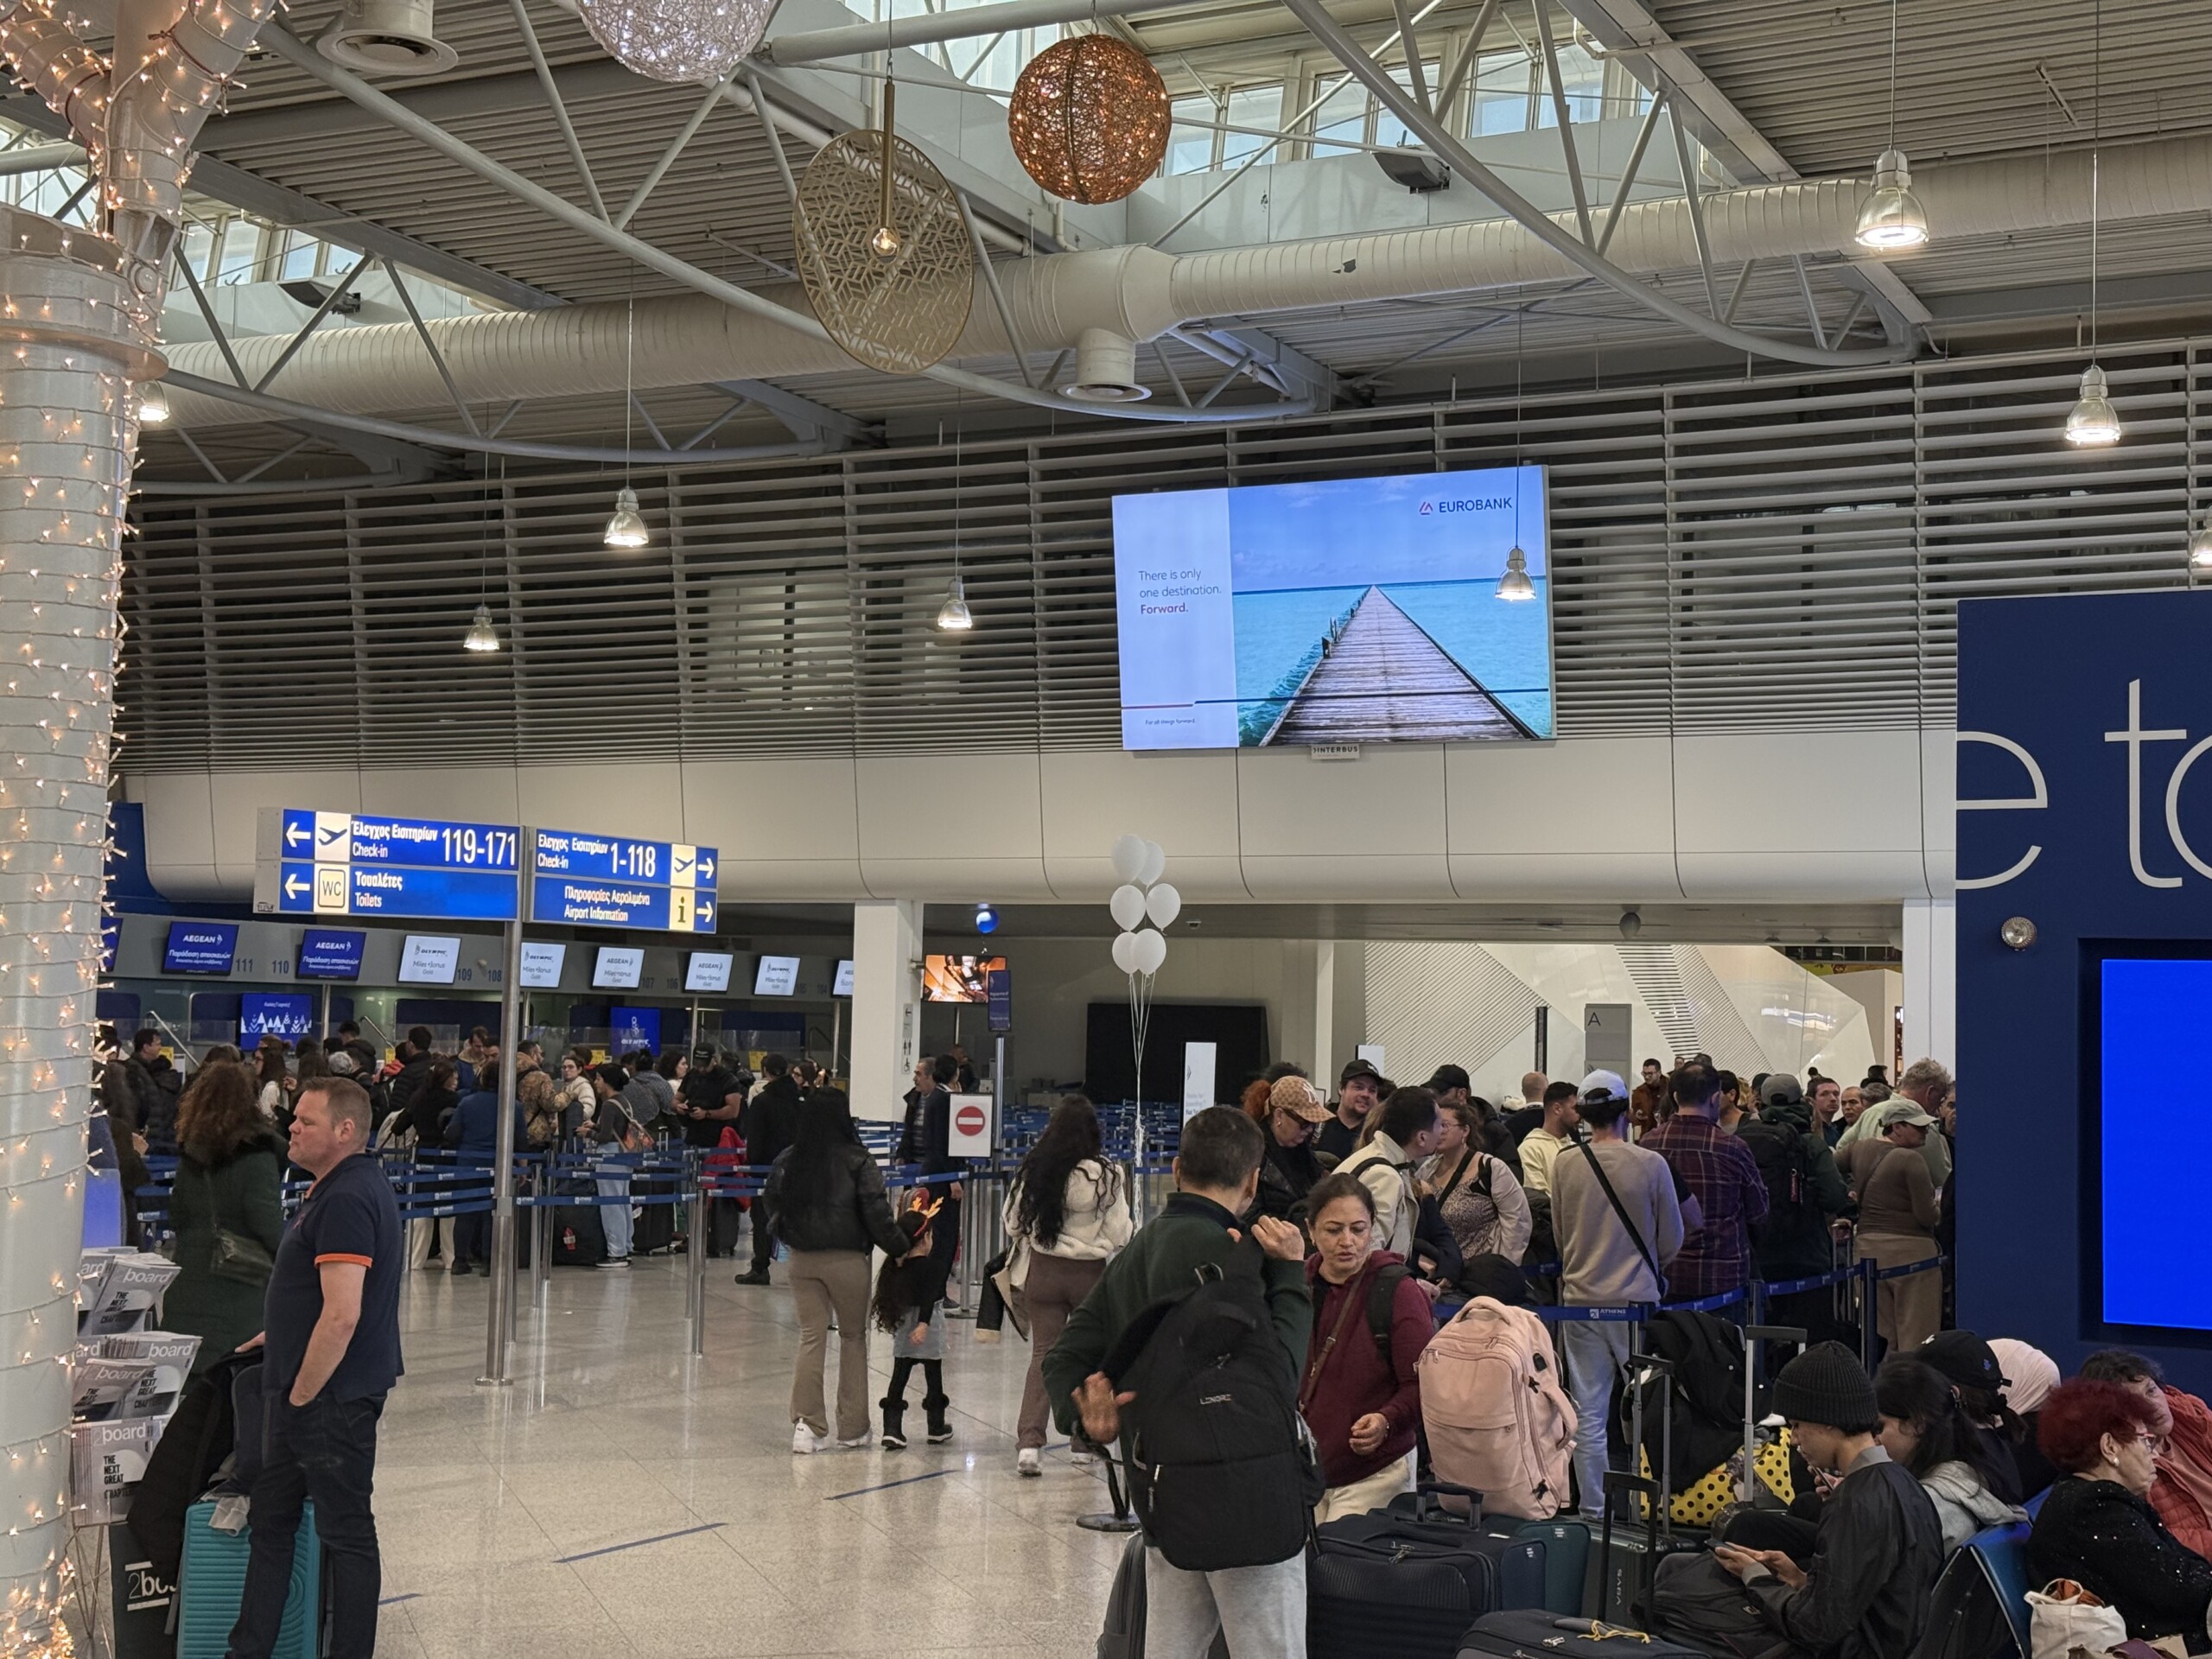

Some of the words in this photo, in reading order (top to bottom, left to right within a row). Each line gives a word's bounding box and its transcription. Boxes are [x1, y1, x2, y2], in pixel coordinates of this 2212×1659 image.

[1439, 497, 1513, 513] EUROBANK
[1138, 570, 1167, 581] There
[1170, 570, 1178, 580] is
[1180, 568, 1202, 581] only
[1140, 589, 1159, 598] one
[1161, 585, 1222, 597] destination.
[1141, 602, 1189, 614] Forward.
[351, 820, 390, 841] Έλεγχος
[353, 842, 388, 858] Check-in
[442, 828, 516, 866] 119-171
[537, 853, 569, 869] Check-in
[610, 842, 657, 878] 1-118
[322, 880, 341, 896] WC
[355, 872, 403, 891] Τουαλέτες
[355, 892, 383, 907] Toilets
[564, 885, 610, 905] Πληροφορίες
[564, 904, 589, 921] Airport
[589, 906, 628, 922] Information
[182, 934, 216, 944] AEGEAN
[315, 941, 346, 950] AEGEAN
[236, 958, 253, 973] 111
[272, 959, 290, 975] 110
[457, 968, 473, 982] 109
[487, 969, 502, 982] 108
[1587, 1012, 1601, 1027] A
[140, 1377, 157, 1388] NEXT
[104, 1454, 117, 1465] THE
[104, 1464, 121, 1475] NEXT
[104, 1473, 124, 1485] GREAT
[128, 1570, 177, 1599] 2bo
